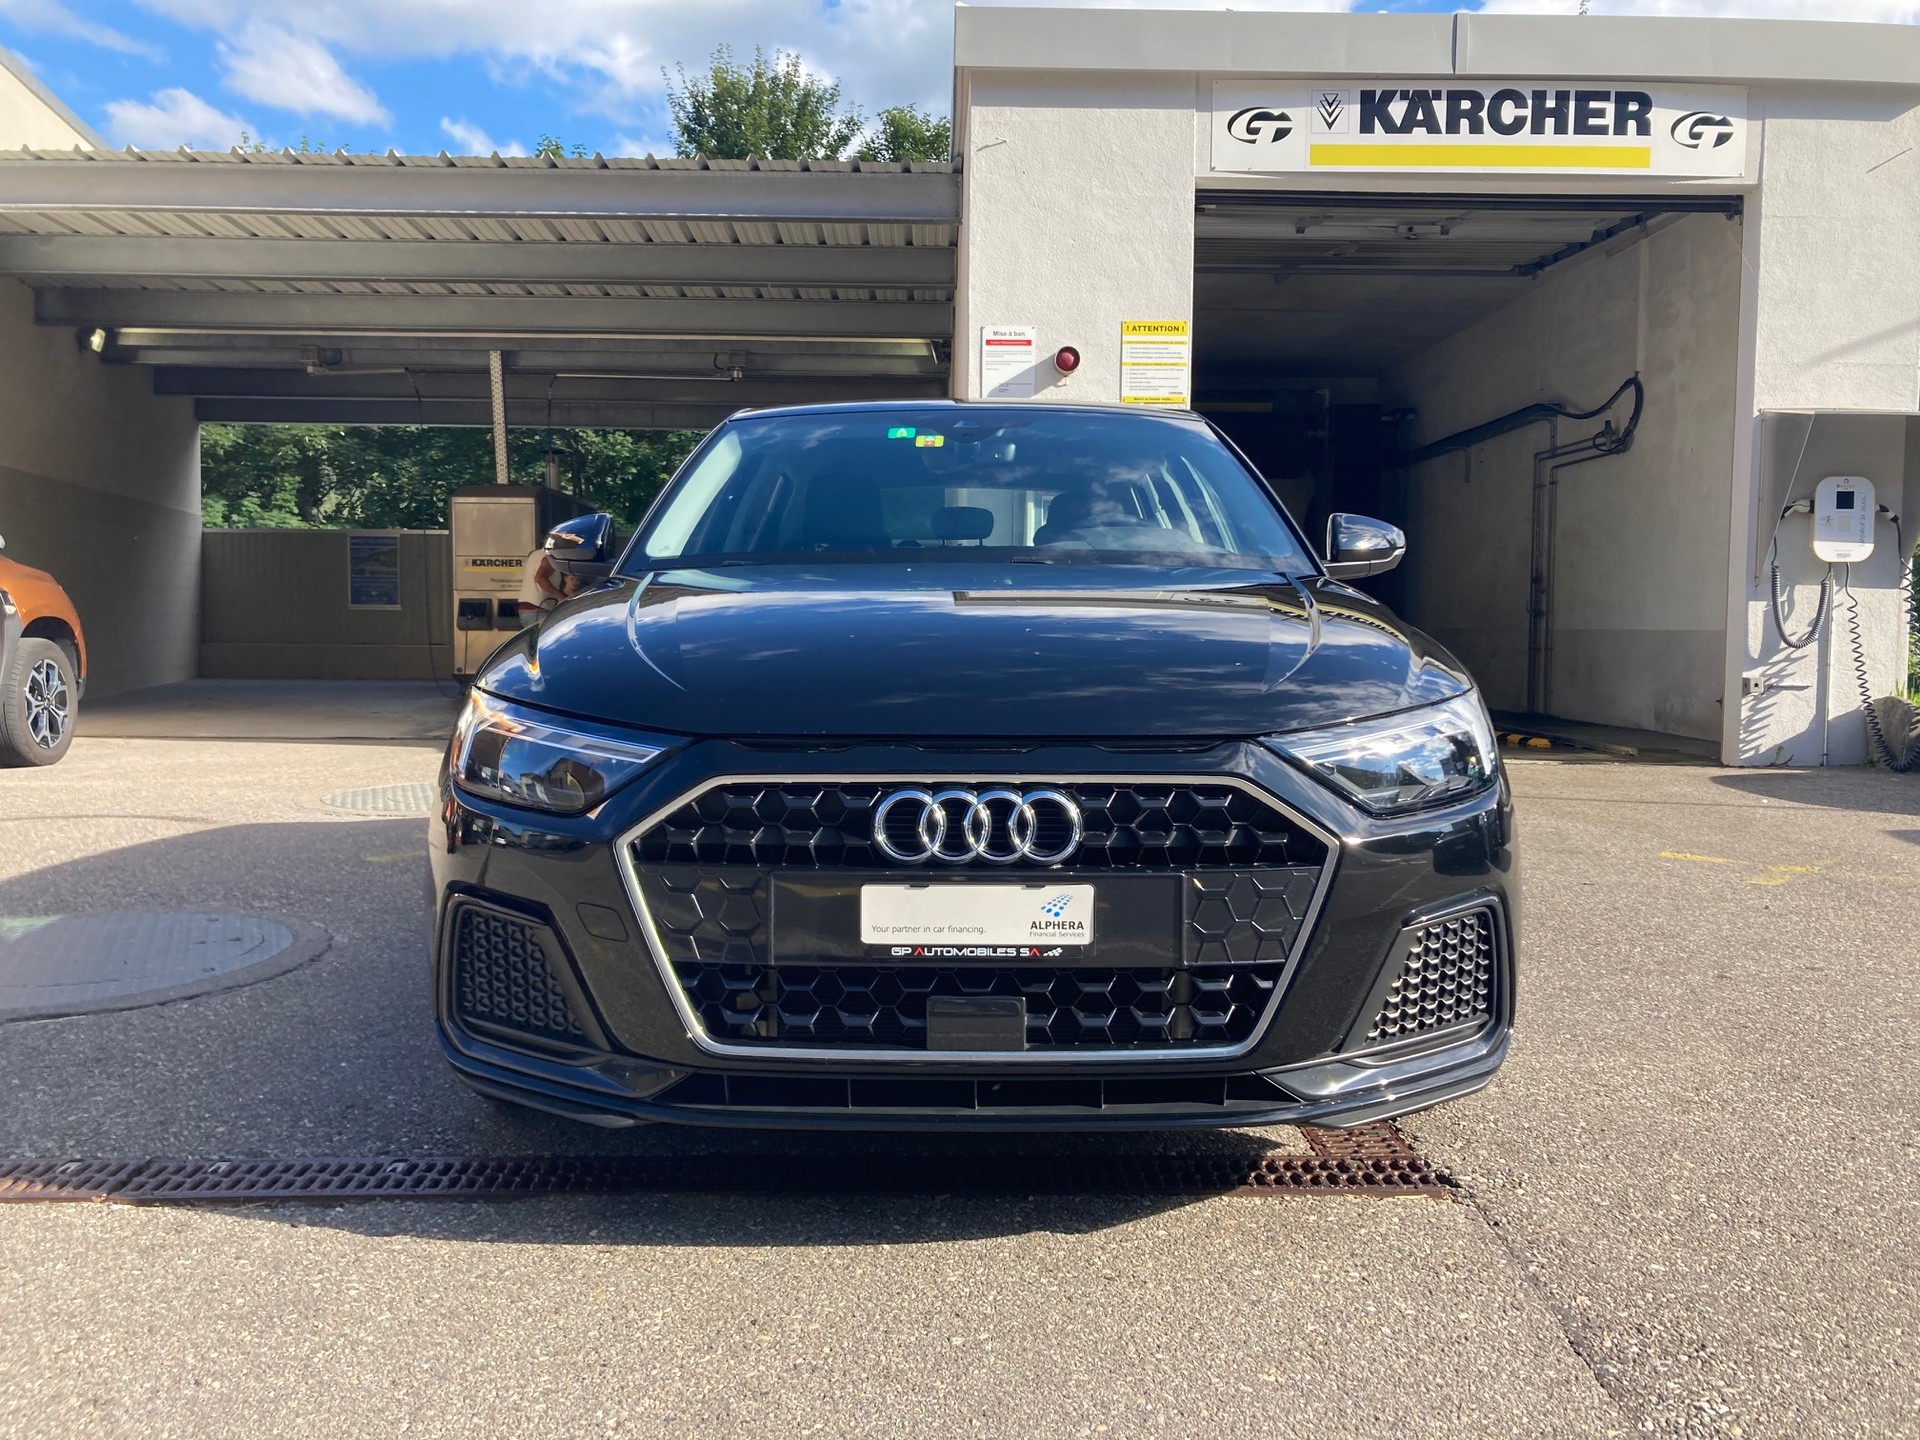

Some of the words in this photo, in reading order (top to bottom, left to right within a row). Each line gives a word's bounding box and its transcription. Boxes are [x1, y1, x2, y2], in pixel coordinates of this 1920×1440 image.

[1359, 88, 1653, 136] KÄRCHER
[871, 925, 889, 933] Your
[892, 925, 921, 935] partner
[923, 925, 931, 933] in
[948, 925, 986, 935] financing.
[1030, 920, 1085, 930] ALPHERA
[891, 946, 912, 956] GP
[913, 946, 1017, 956] AUTOMOBILES
[1019, 946, 1040, 956] SA
